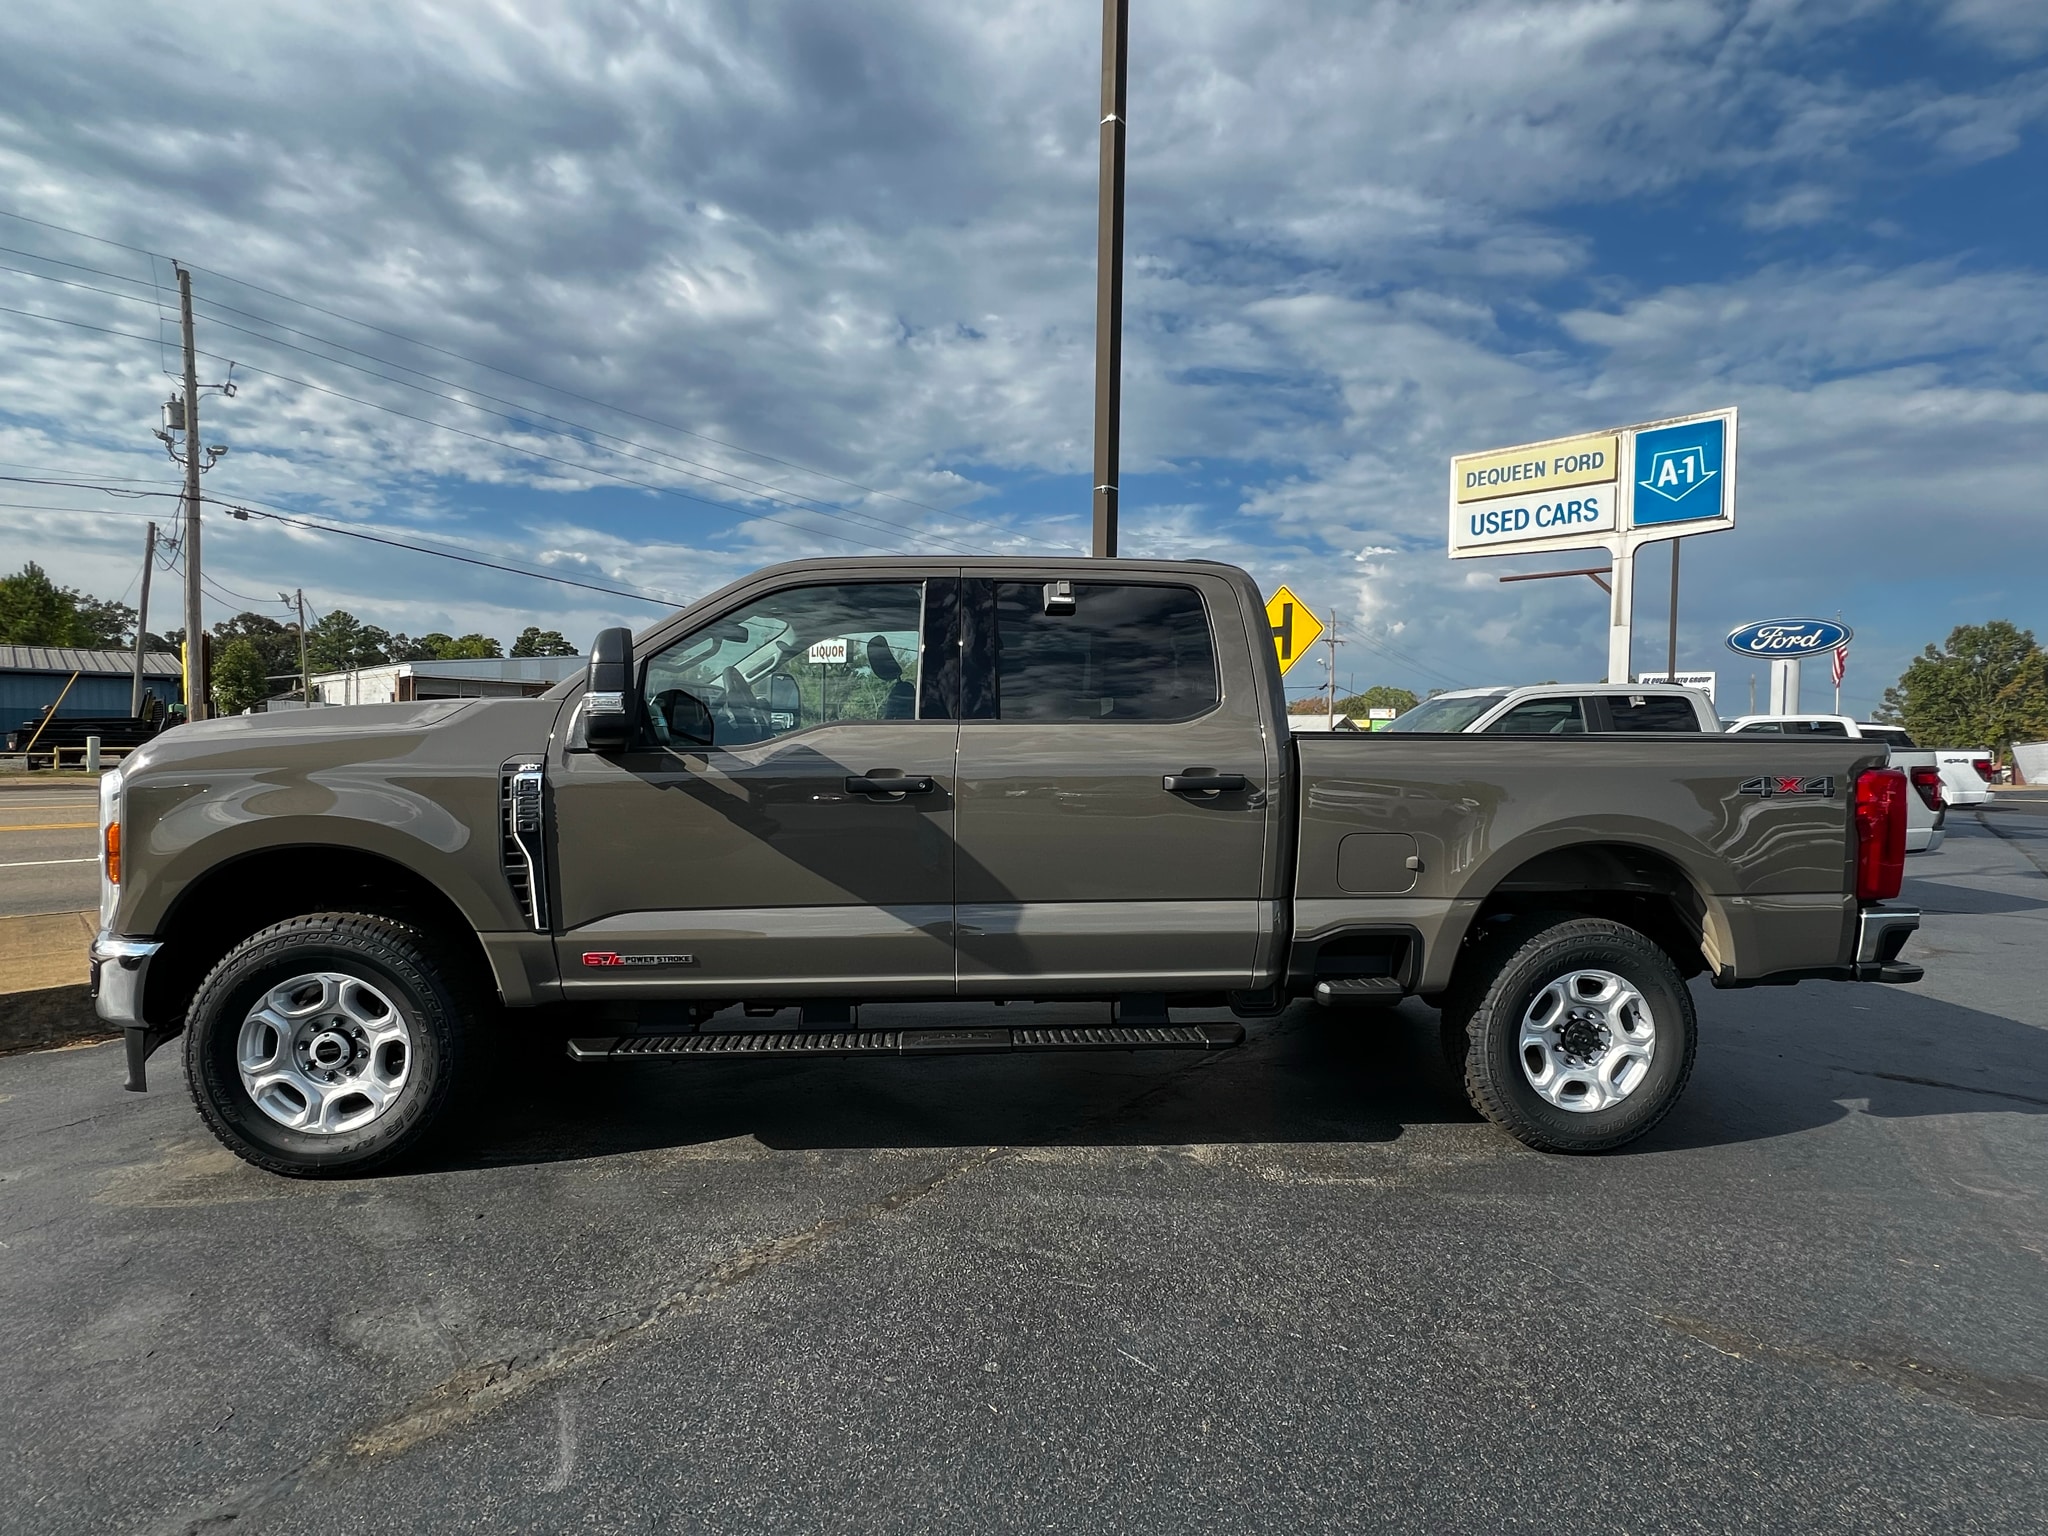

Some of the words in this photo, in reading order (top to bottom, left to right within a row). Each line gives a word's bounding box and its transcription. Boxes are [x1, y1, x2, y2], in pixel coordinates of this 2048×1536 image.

[1466, 460, 1546, 488] DEQUEEN
[1554, 452, 1604, 475] FORD
[1656, 455, 1695, 488] A-1
[1470, 508, 1530, 536] USED
[1535, 497, 1599, 528] CARS
[1750, 624, 1824, 650] Ford
[811, 645, 845, 660] LIQUOR
[625, 956, 655, 964] POWER
[656, 955, 691, 963] STROKE
